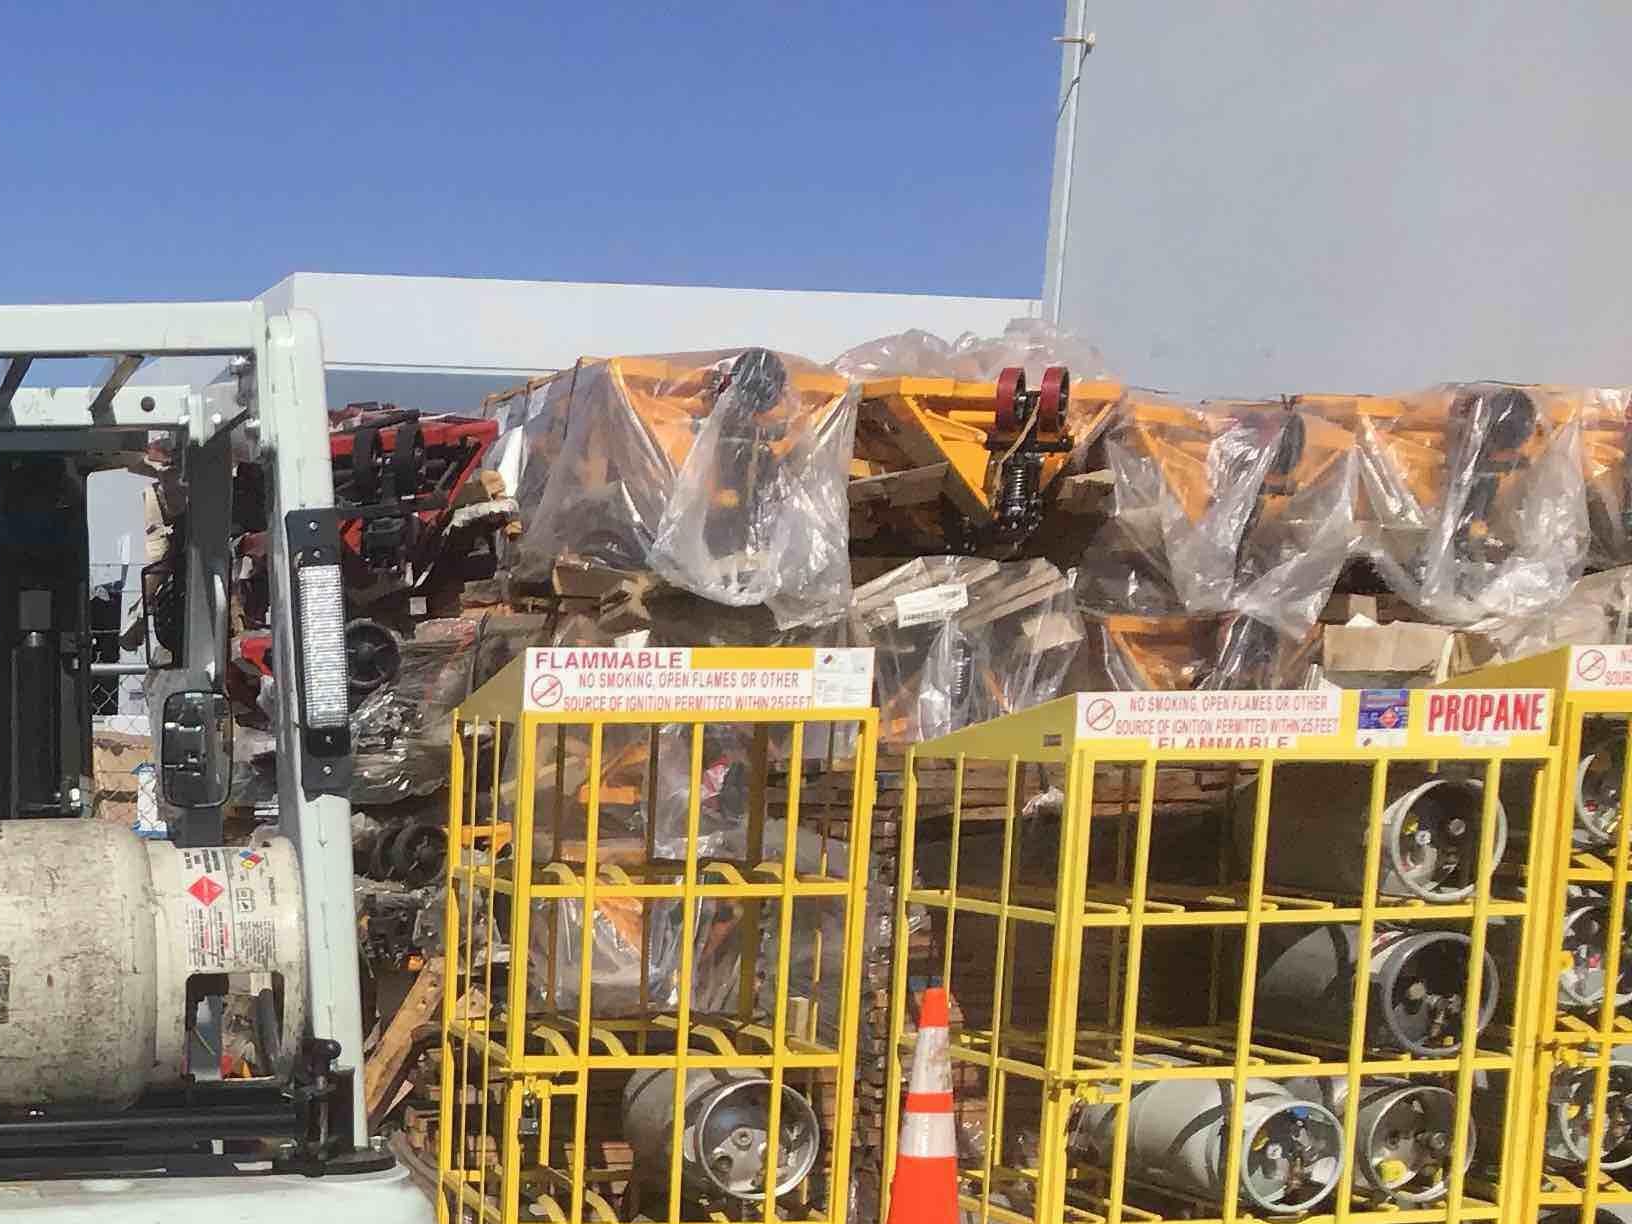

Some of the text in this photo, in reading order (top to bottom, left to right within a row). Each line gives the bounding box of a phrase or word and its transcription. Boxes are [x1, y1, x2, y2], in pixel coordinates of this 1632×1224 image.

[535, 651, 683, 669] FLAMMABLE
[579, 672, 596, 688] NO
[659, 671, 689, 688] OPEN
[692, 671, 737, 688] FLAMES
[741, 671, 757, 688] OR
[759, 671, 800, 688] OTHER
[563, 696, 607, 711] SOURCE
[609, 696, 624, 711] OF
[626, 695, 671, 711] IGNITION
[674, 695, 732, 711] PERMITTED
[734, 695, 769, 711] WITHIN
[1130, 696, 1145, 712] NO
[1202, 696, 1229, 711] OPEN
[1232, 696, 1272, 711] FLAMES
[1276, 696, 1289, 711] OR
[1295, 695, 1328, 711] OTHER
[1428, 693, 1545, 732] PROPANE
[1115, 719, 1155, 735] SOURCE
[1157, 719, 1170, 735] OF
[1172, 719, 1212, 734] IGNITION
[1216, 718, 1267, 734] PERMITTED
[1270, 718, 1299, 733] WITHIN
[1158, 736, 1289, 749] FLAMMABLE
